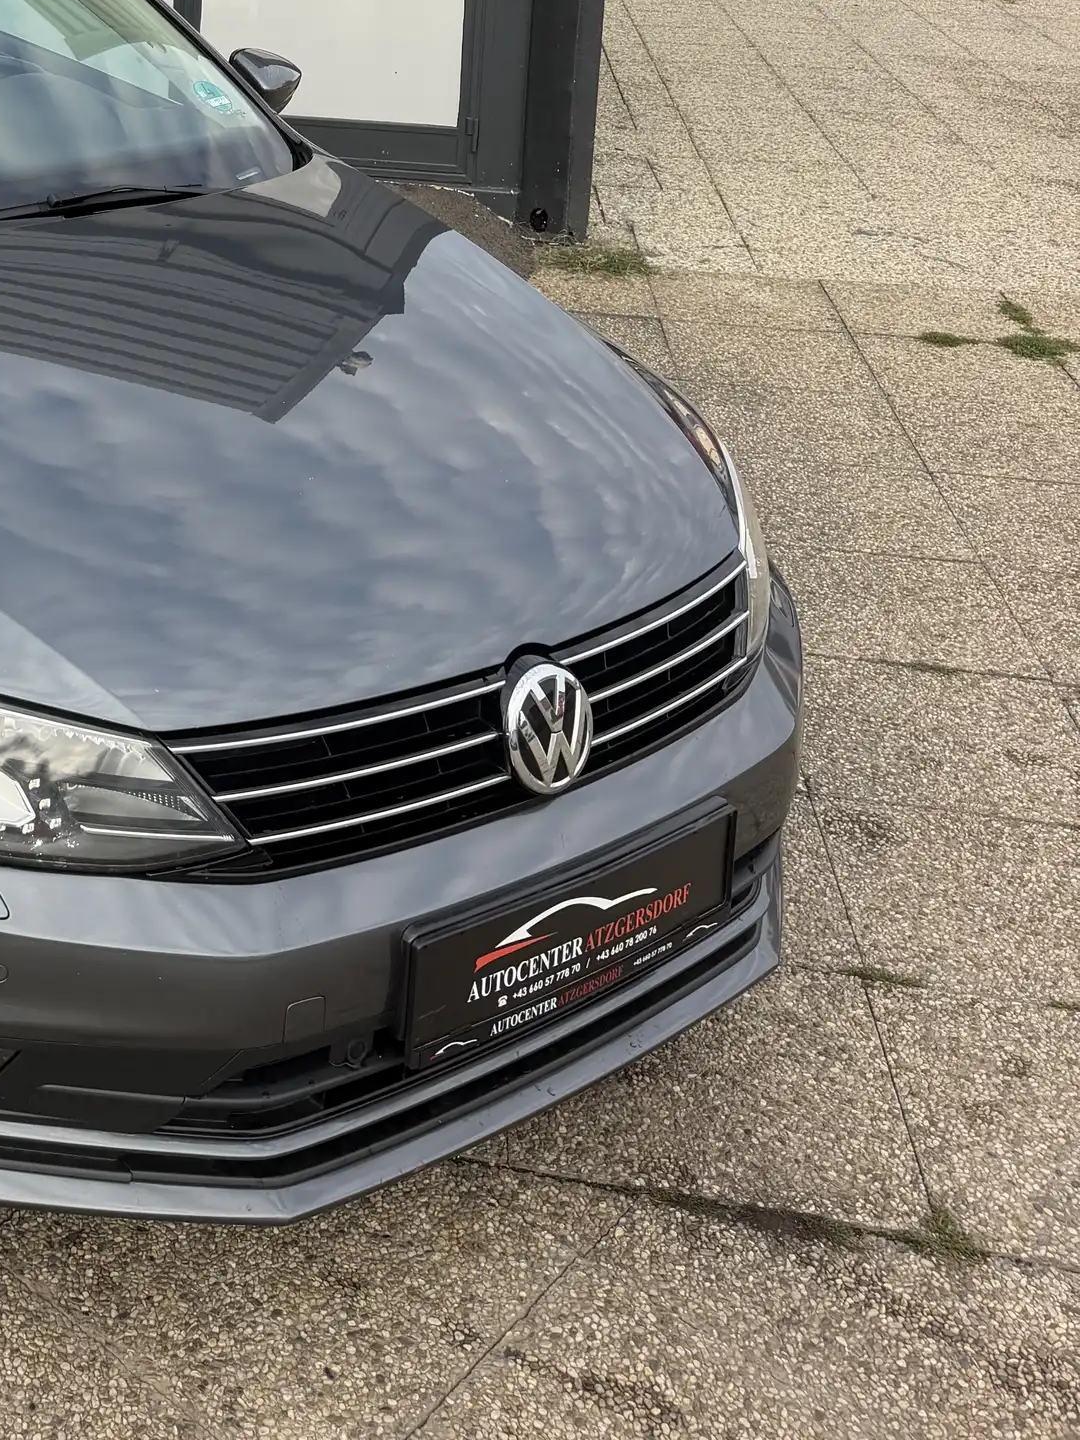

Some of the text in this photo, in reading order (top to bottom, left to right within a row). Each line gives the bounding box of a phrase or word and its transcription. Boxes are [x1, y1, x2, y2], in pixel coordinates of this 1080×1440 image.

[508, 663, 593, 795] VW
[467, 882, 692, 1003] AUTOCENTER ATZGERSDORF
[512, 987, 527, 999] +43
[528, 980, 543, 994] 660
[544, 975, 555, 986] 57
[556, 968, 570, 981] 778
[571, 963, 581, 975] 70
[595, 948, 610, 961] +43
[610, 942, 624, 956] 660
[625, 939, 634, 949] 78
[634, 930, 648, 944] 200
[648, 925, 657, 937] 76
[490, 997, 558, 1037] AUTOCENTER
[557, 965, 623, 1007] ATZGERSDORF
